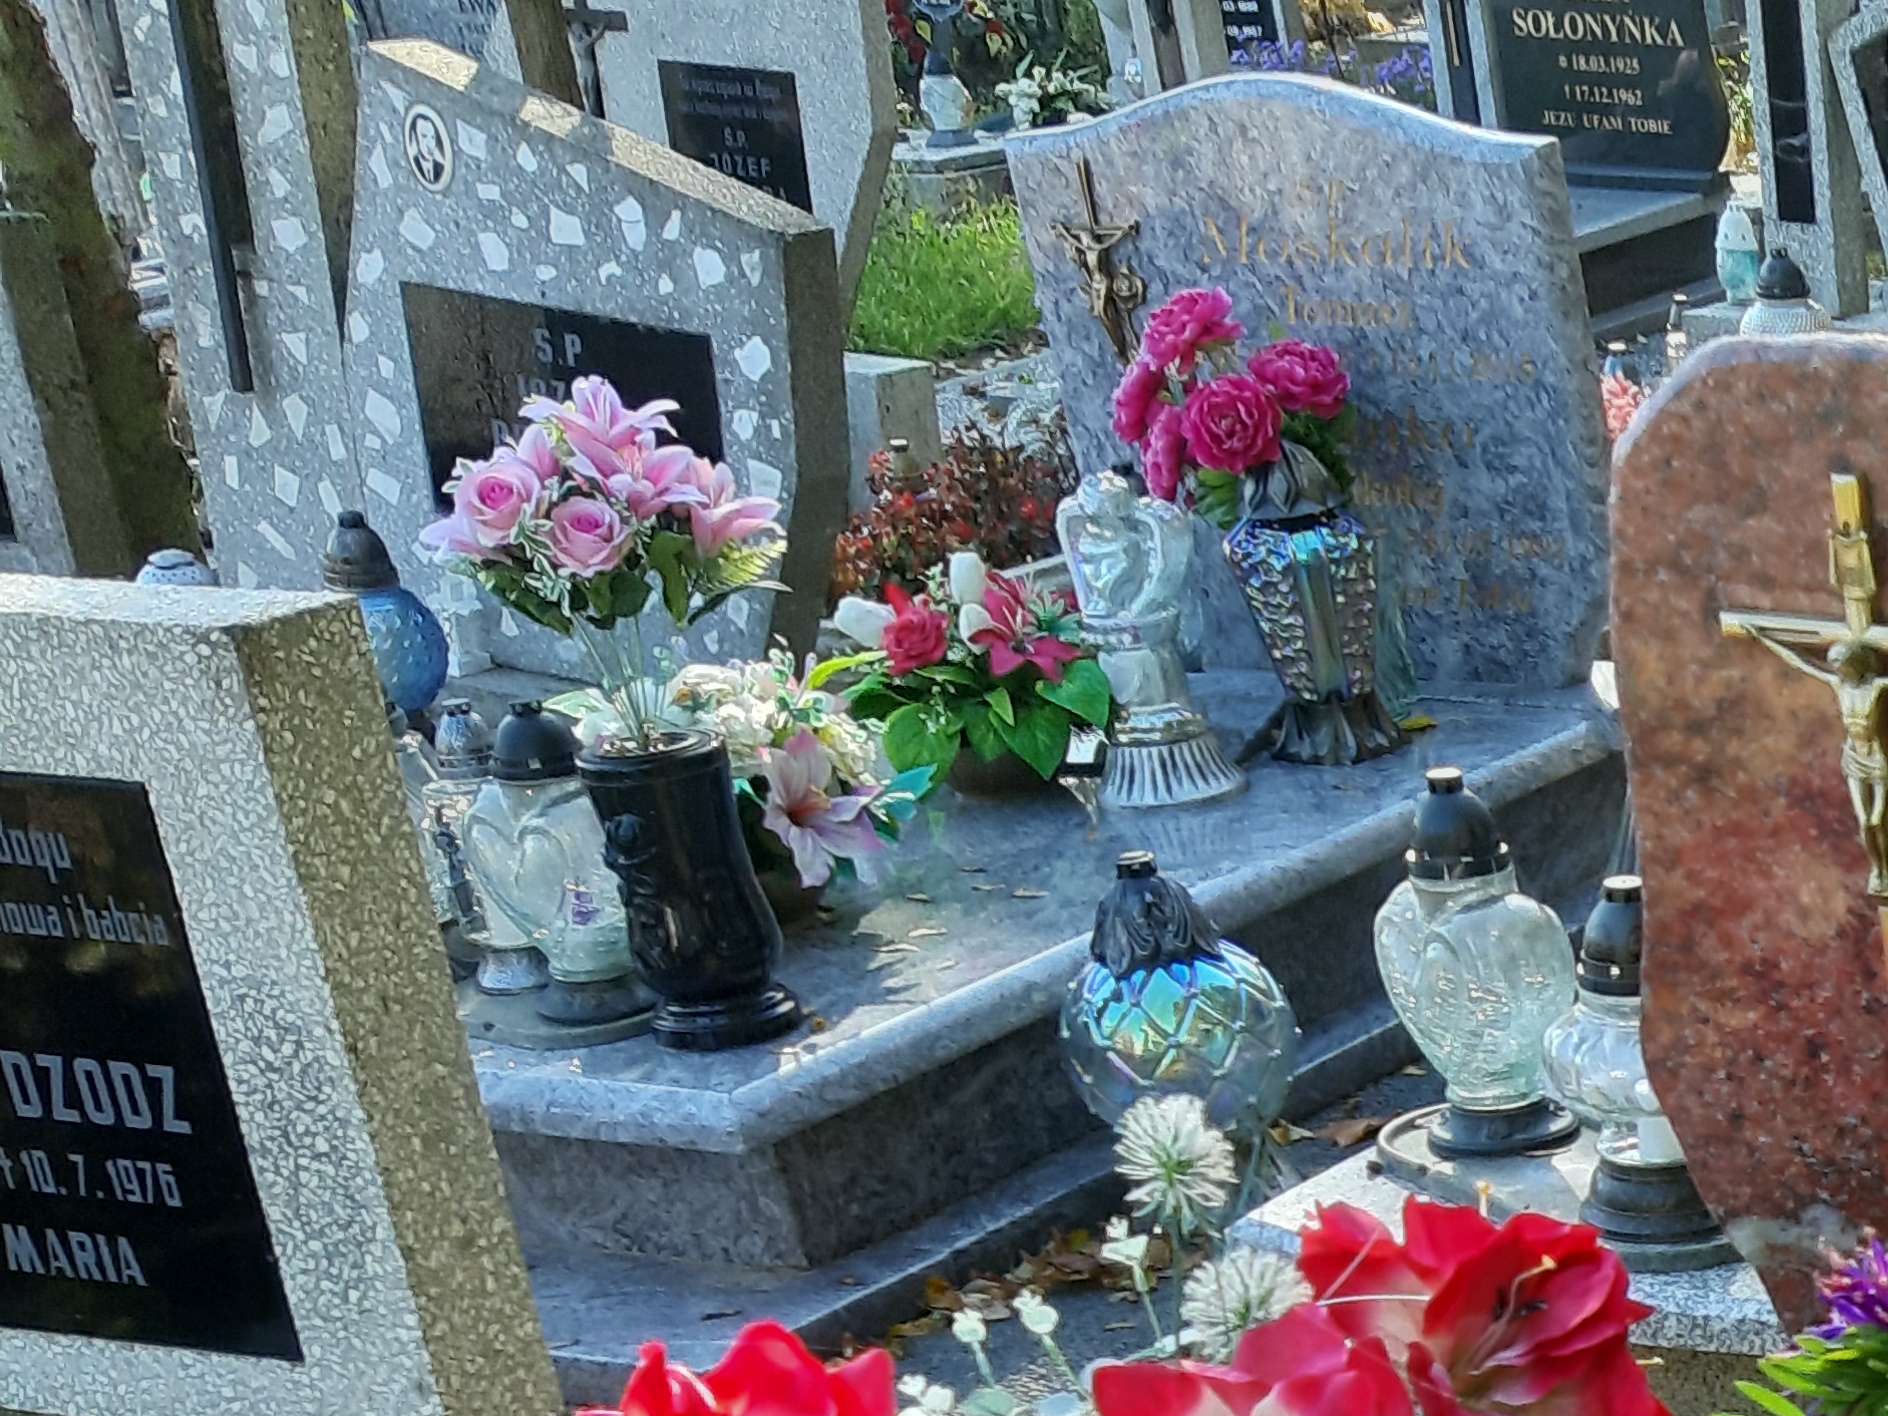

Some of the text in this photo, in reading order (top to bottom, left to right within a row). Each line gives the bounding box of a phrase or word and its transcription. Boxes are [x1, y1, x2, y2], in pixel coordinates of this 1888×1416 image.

[1629, 117, 1673, 135] TOBIE
[1201, 211, 1474, 270] Moskalik
[77, 893, 170, 946] babcia
[2, 1223, 150, 1287] MARIA
